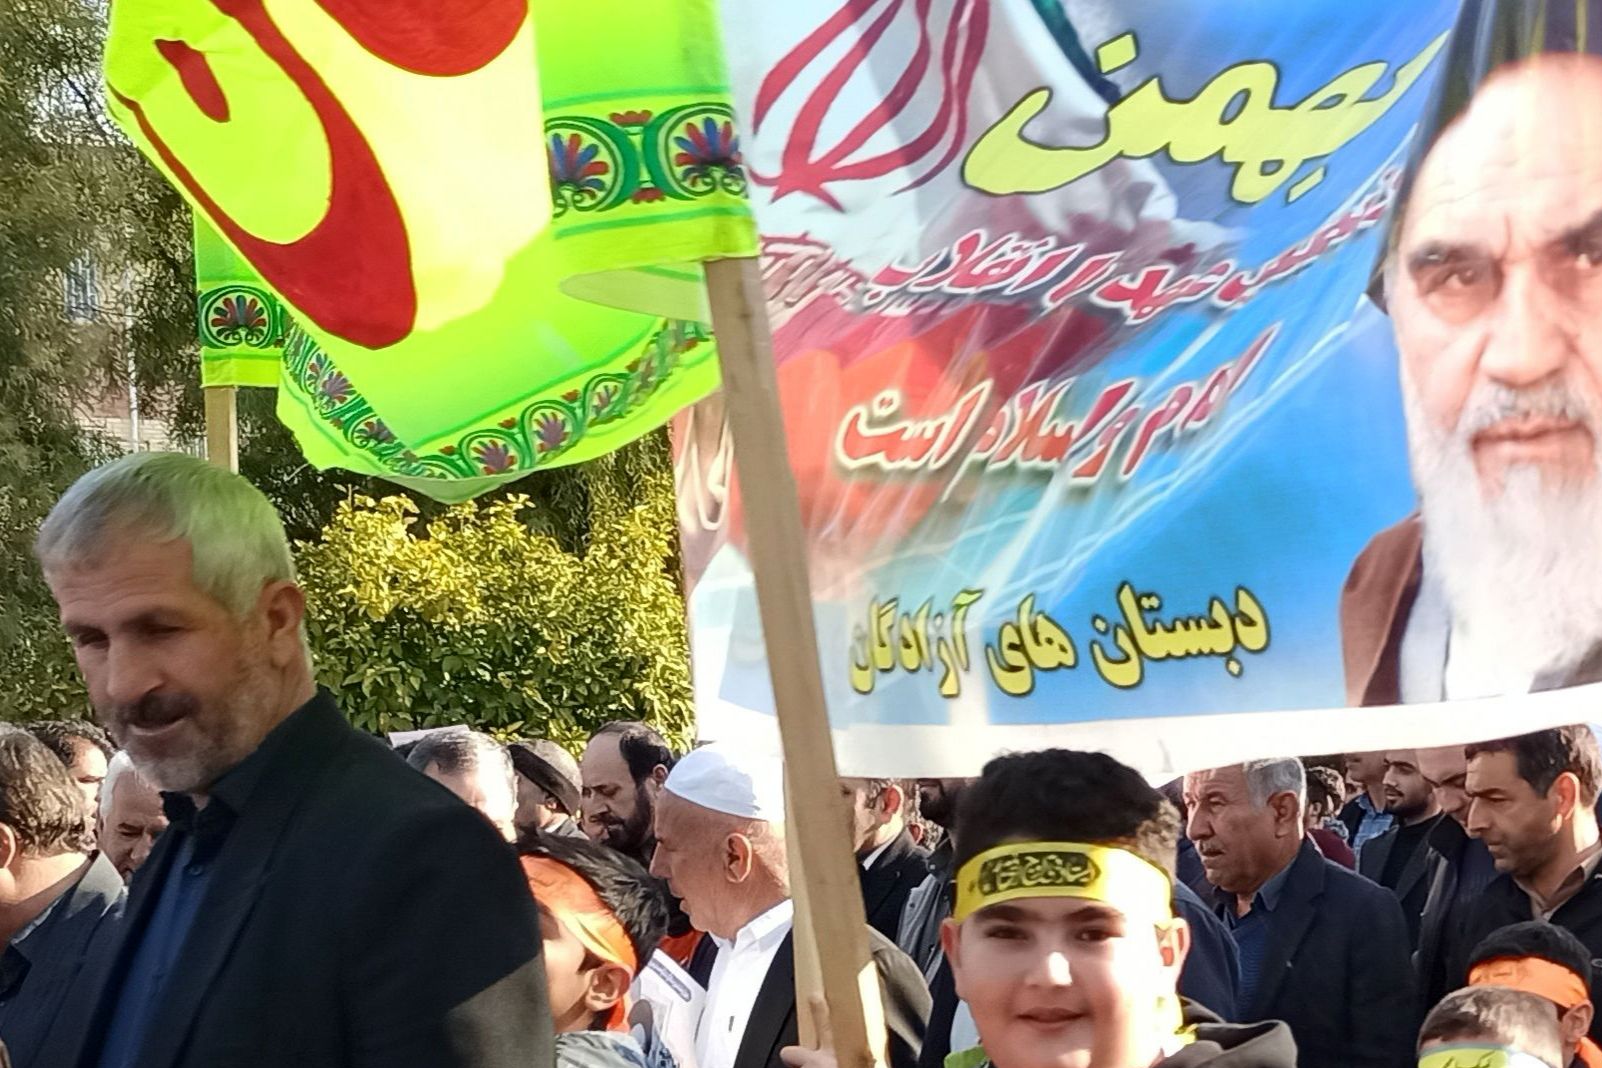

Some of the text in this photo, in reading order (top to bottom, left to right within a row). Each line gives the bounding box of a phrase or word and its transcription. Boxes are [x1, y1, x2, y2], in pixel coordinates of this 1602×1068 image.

[962, 31, 1442, 206] بهمن
[863, 228, 1080, 311] انقلاب
[834, 378, 995, 474] است
[849, 581, 1271, 699] دبستان های آزادگان
